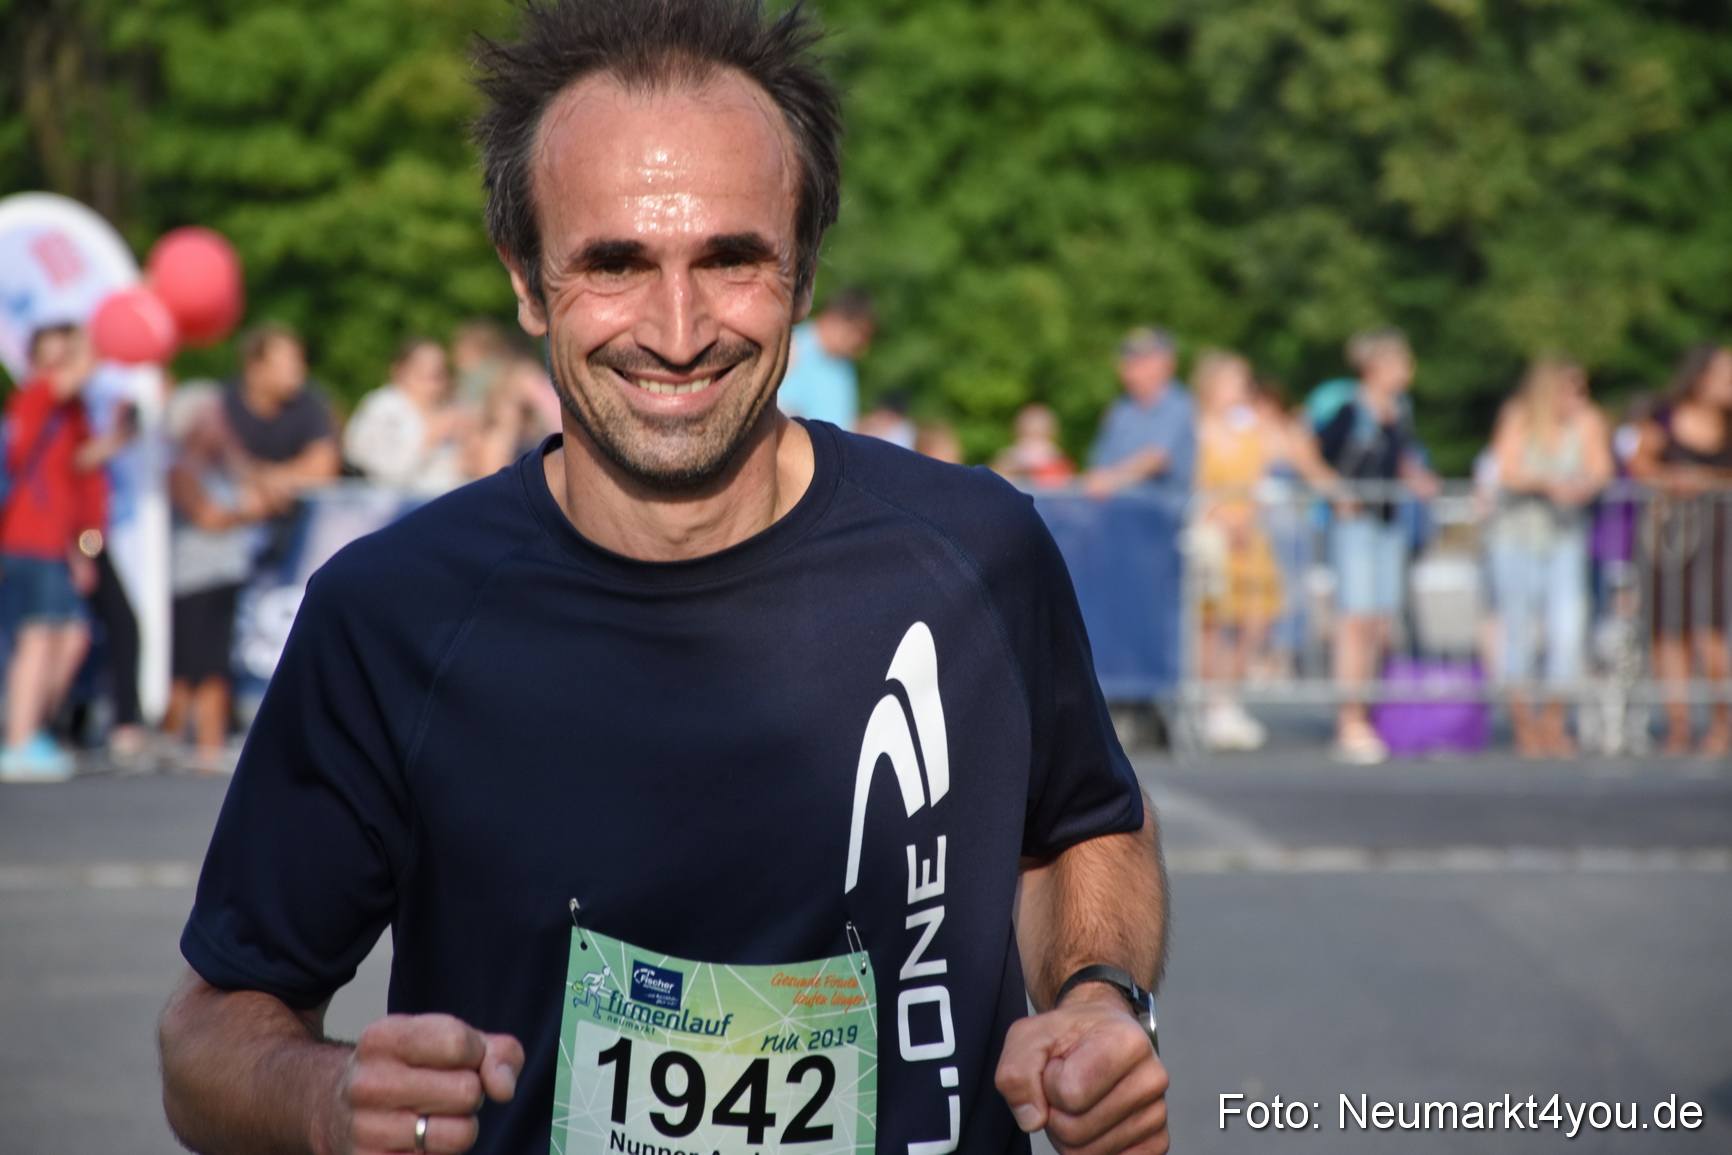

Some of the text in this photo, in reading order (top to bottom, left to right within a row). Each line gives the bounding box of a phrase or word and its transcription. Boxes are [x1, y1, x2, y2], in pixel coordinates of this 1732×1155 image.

[771, 972, 821, 988] Gesunde
[792, 989, 828, 1009] laufen
[607, 1014, 656, 1036] neumarkt
[609, 989, 734, 1037] firmenlauf
[760, 1025, 859, 1054] run 2019
[598, 1036, 836, 1145] 1942
